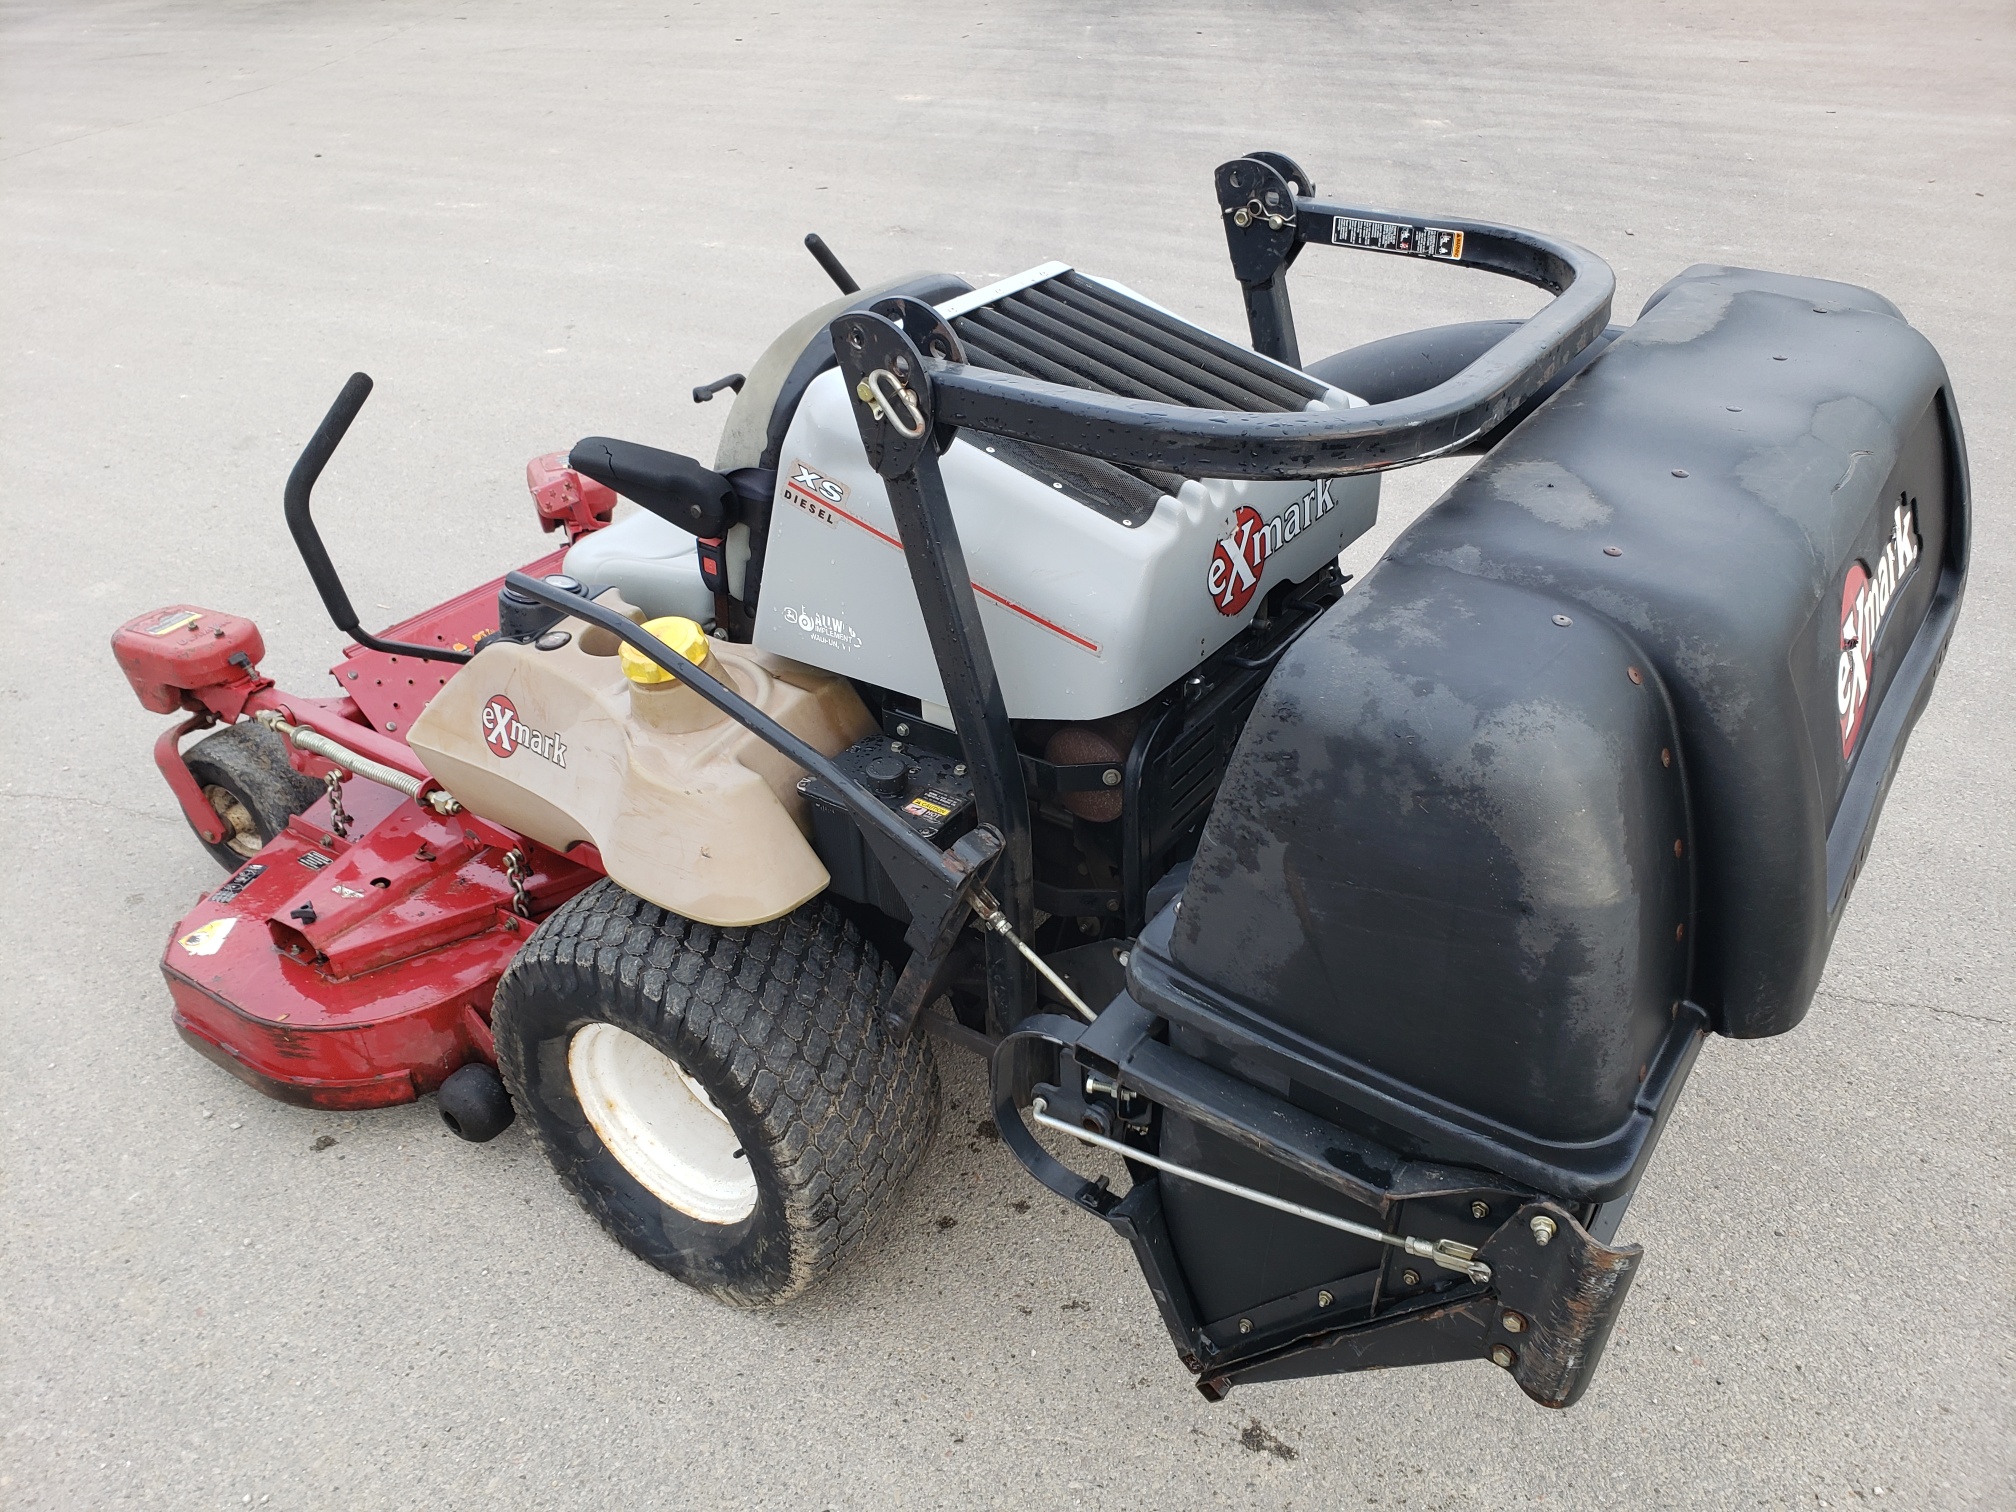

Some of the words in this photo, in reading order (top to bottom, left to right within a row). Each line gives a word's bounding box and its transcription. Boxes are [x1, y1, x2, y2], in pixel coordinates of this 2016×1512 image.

[791, 463, 844, 503] XS
[784, 490, 833, 524] DIESEL
[815, 625, 853, 644] IMPLEMENT
[921, 801, 947, 815] CAUTION
